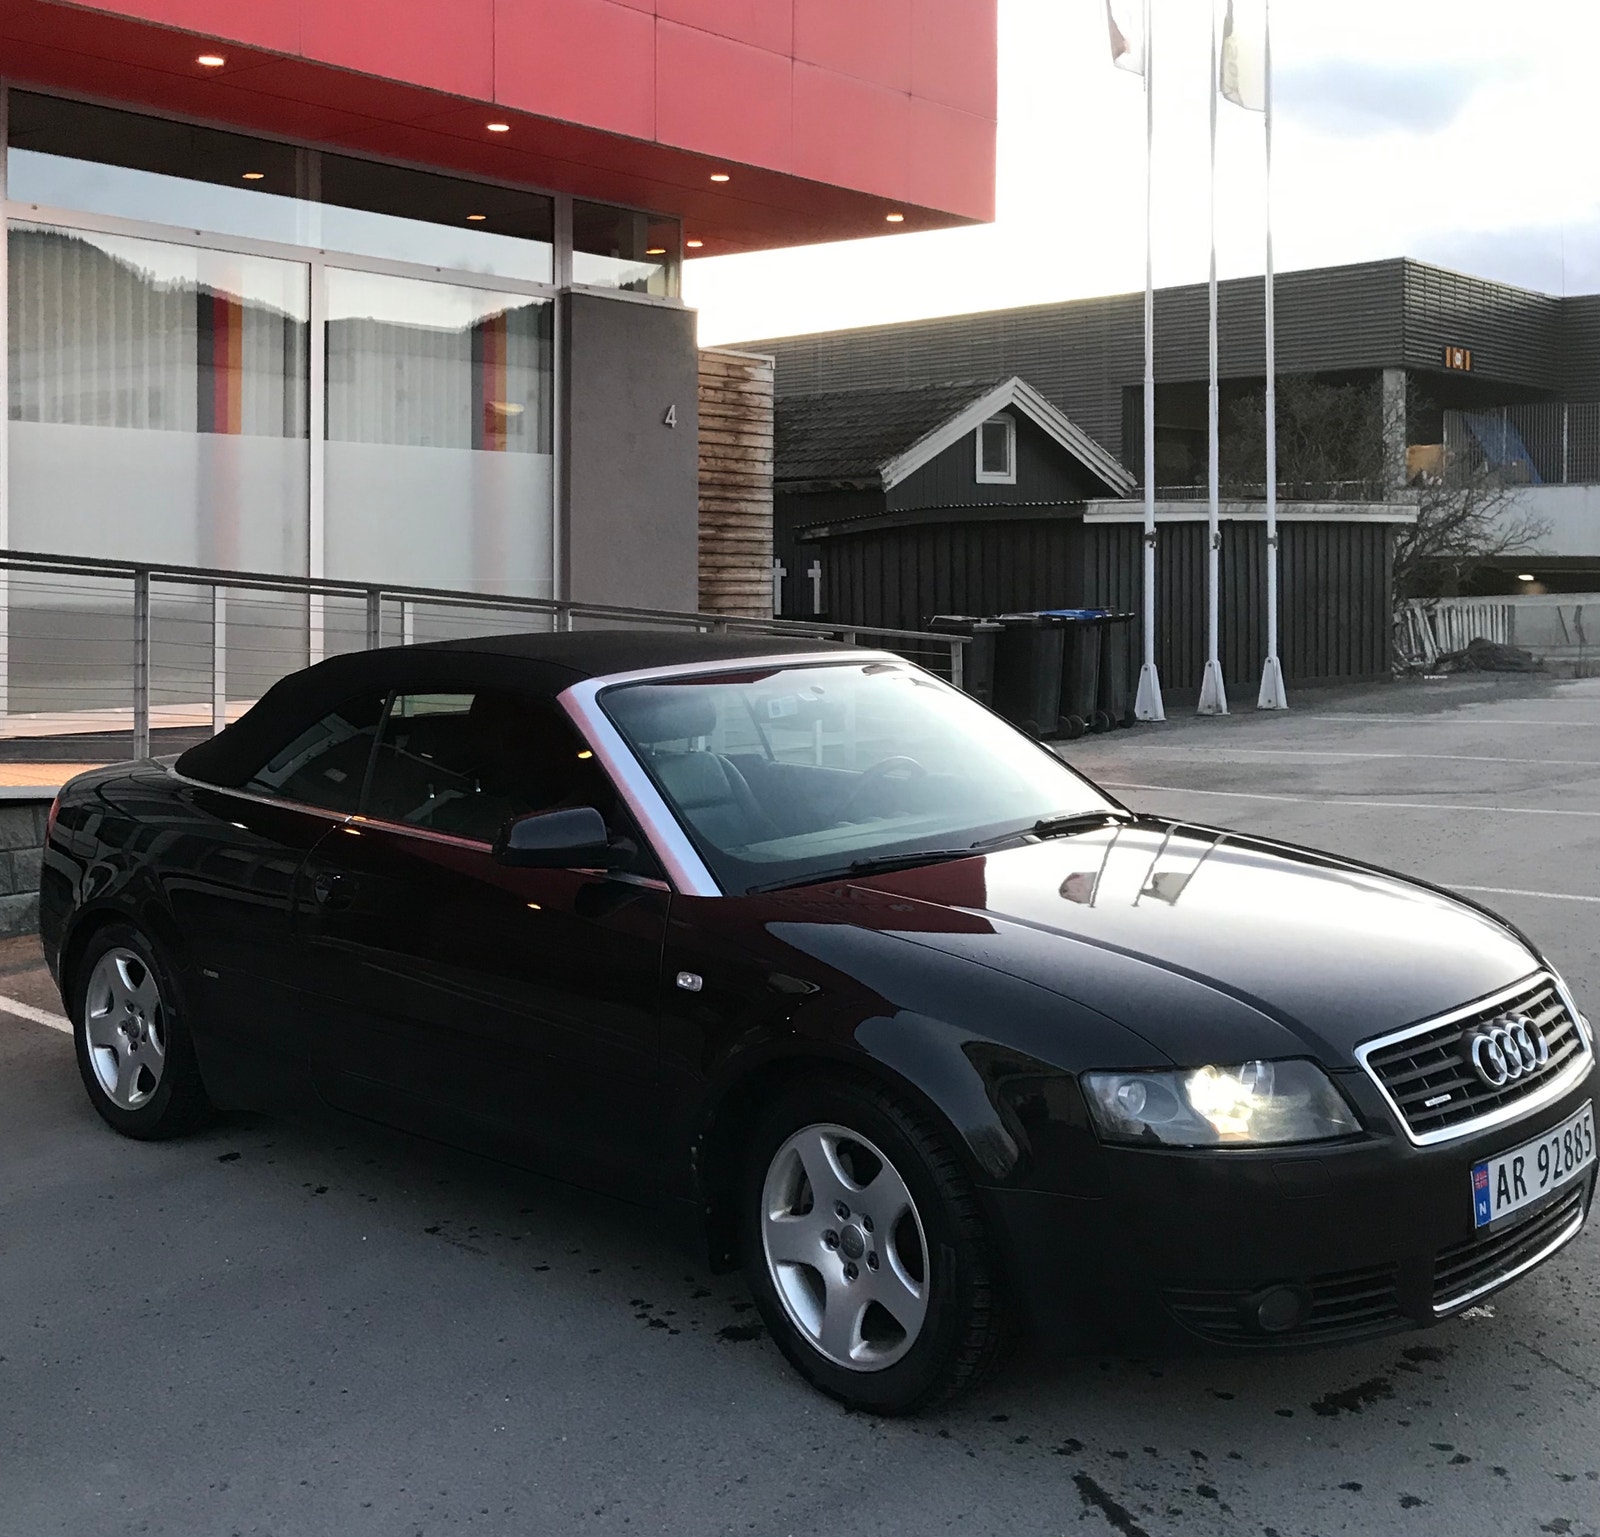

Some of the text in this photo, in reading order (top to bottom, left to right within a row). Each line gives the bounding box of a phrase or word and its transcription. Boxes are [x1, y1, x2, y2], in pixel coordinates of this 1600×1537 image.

[665, 404, 677, 428] 4
[1496, 1156, 1528, 1210] AR
[1537, 1114, 1592, 1188] 92885
[1479, 1201, 1487, 1216] N
